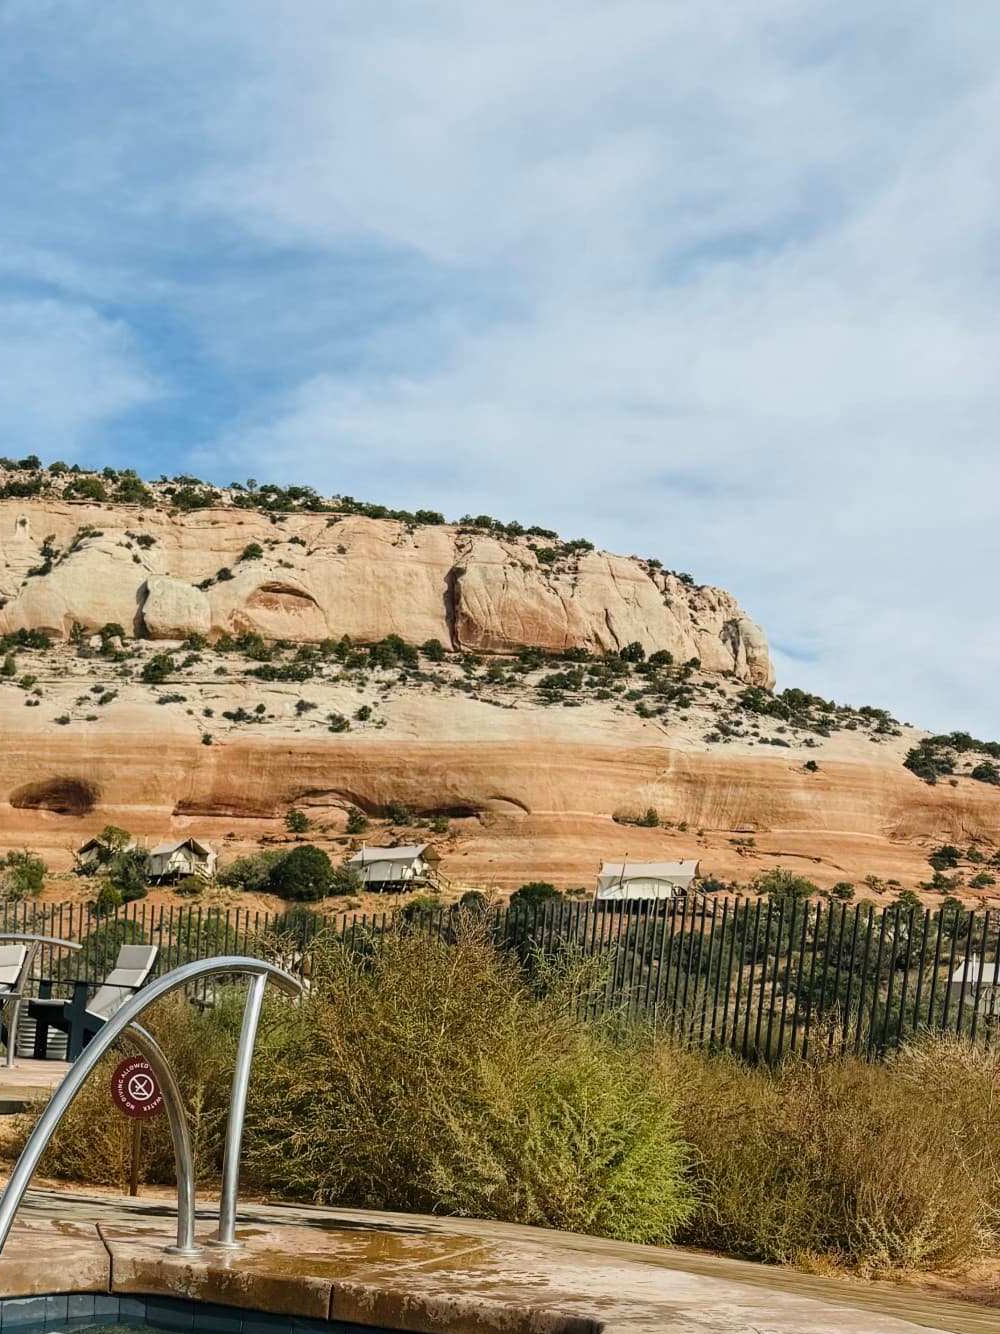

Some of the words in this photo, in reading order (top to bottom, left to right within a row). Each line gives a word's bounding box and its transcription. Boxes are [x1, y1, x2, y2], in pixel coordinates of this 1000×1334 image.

[120, 1062, 149, 1078] ALLOWED
[117, 1078, 127, 1103] DIVING
[125, 1101, 136, 1111] NO
[142, 1096, 162, 1112] WATER
